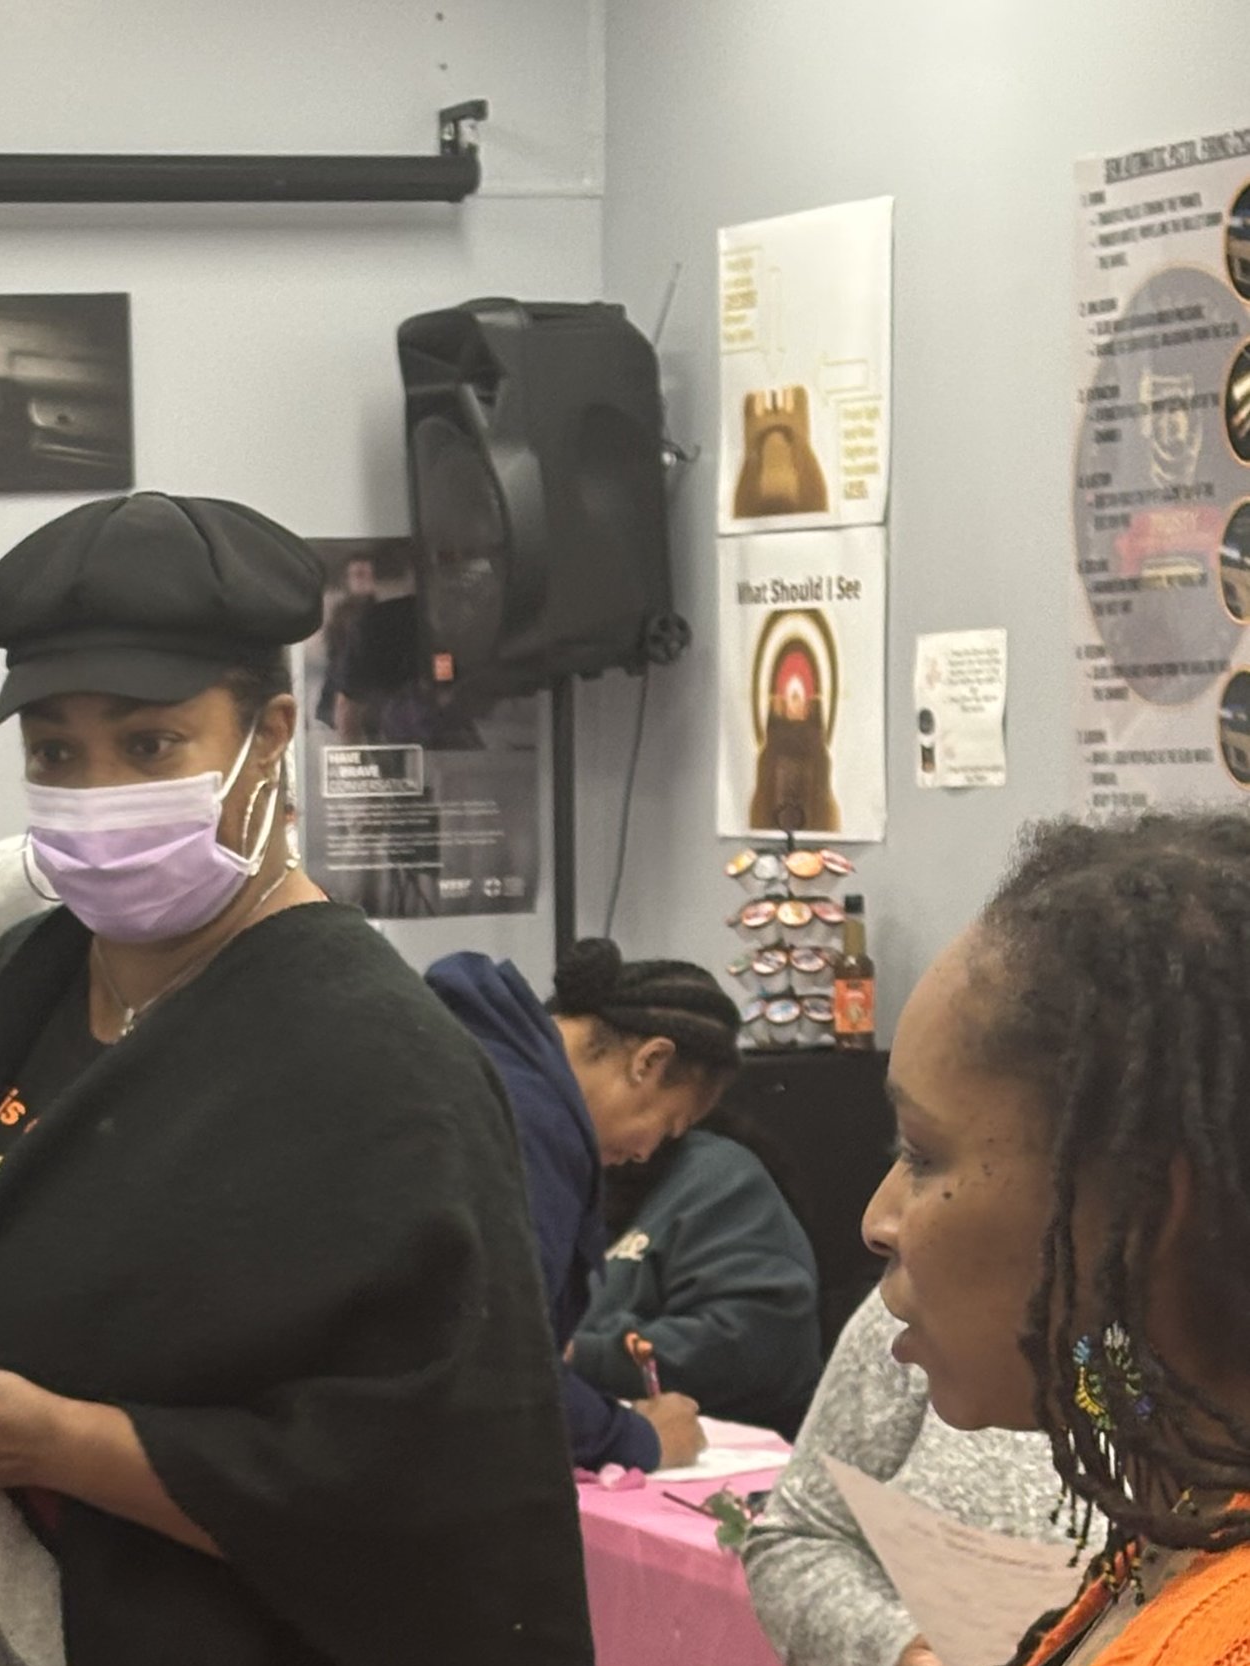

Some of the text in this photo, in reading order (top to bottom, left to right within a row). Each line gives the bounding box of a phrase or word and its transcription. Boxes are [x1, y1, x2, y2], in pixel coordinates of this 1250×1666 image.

[769, 575, 824, 604] Should
[826, 575, 834, 602] I
[836, 574, 863, 601] See
